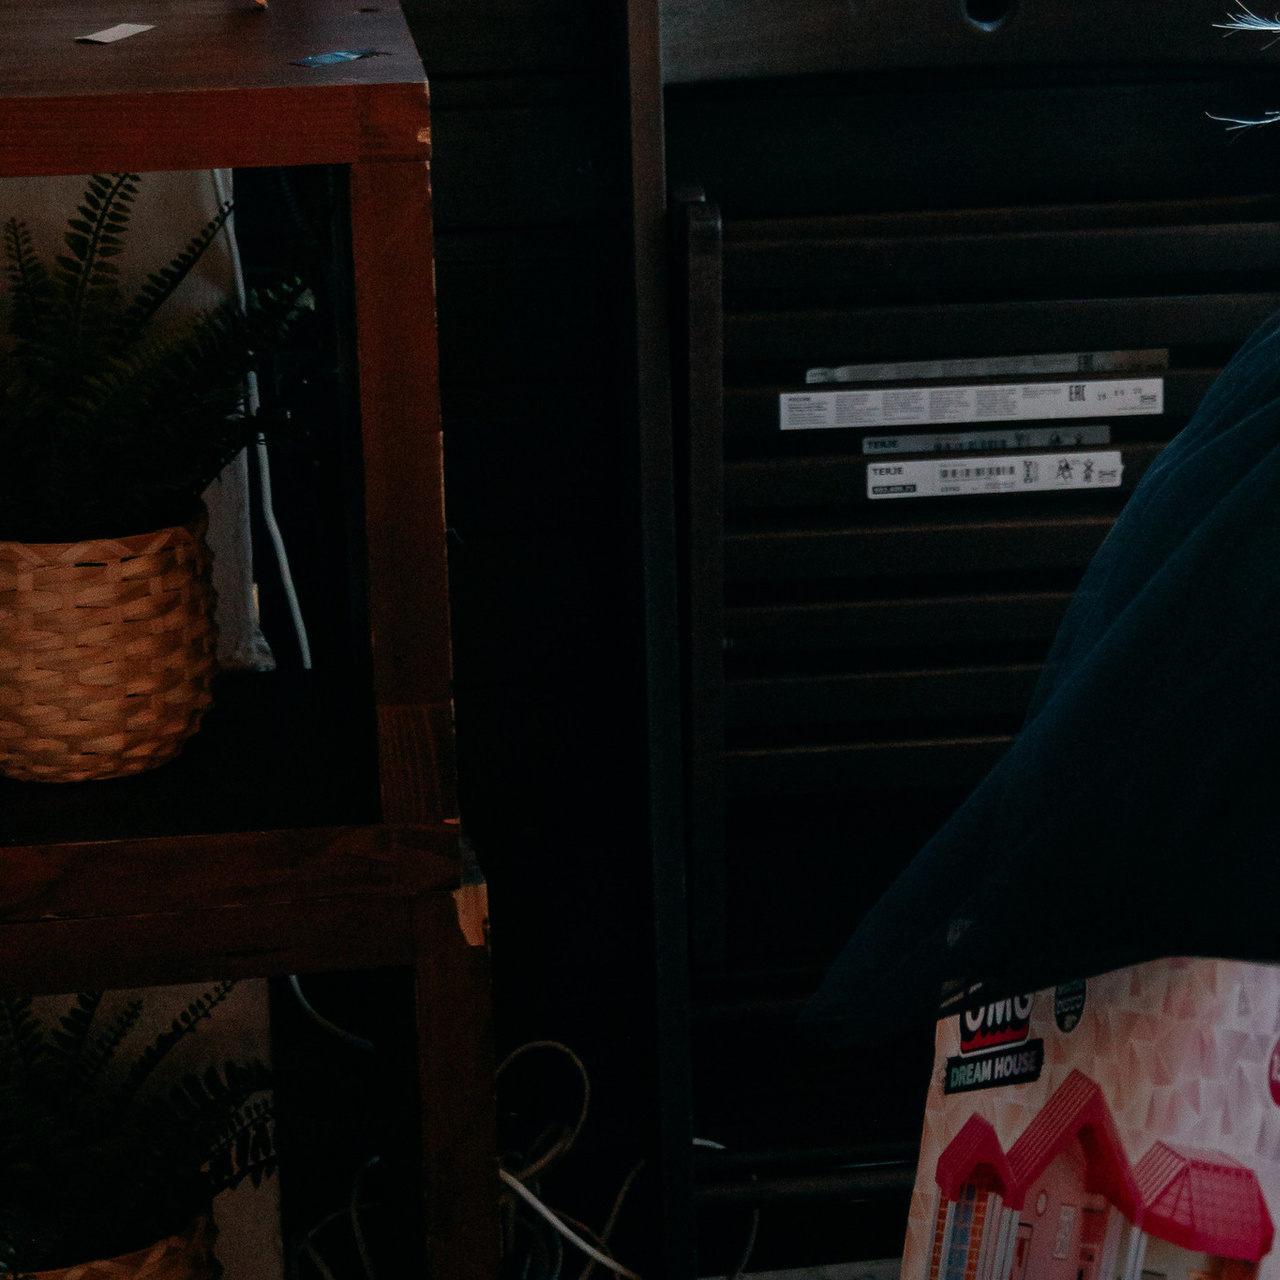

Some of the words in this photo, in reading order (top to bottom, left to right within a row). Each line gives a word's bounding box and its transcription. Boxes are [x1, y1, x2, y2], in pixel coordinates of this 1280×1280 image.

[872, 466, 904, 477] TERJE
[949, 1059, 993, 1089] DREAM
[994, 1050, 1037, 1080] HOUSE
